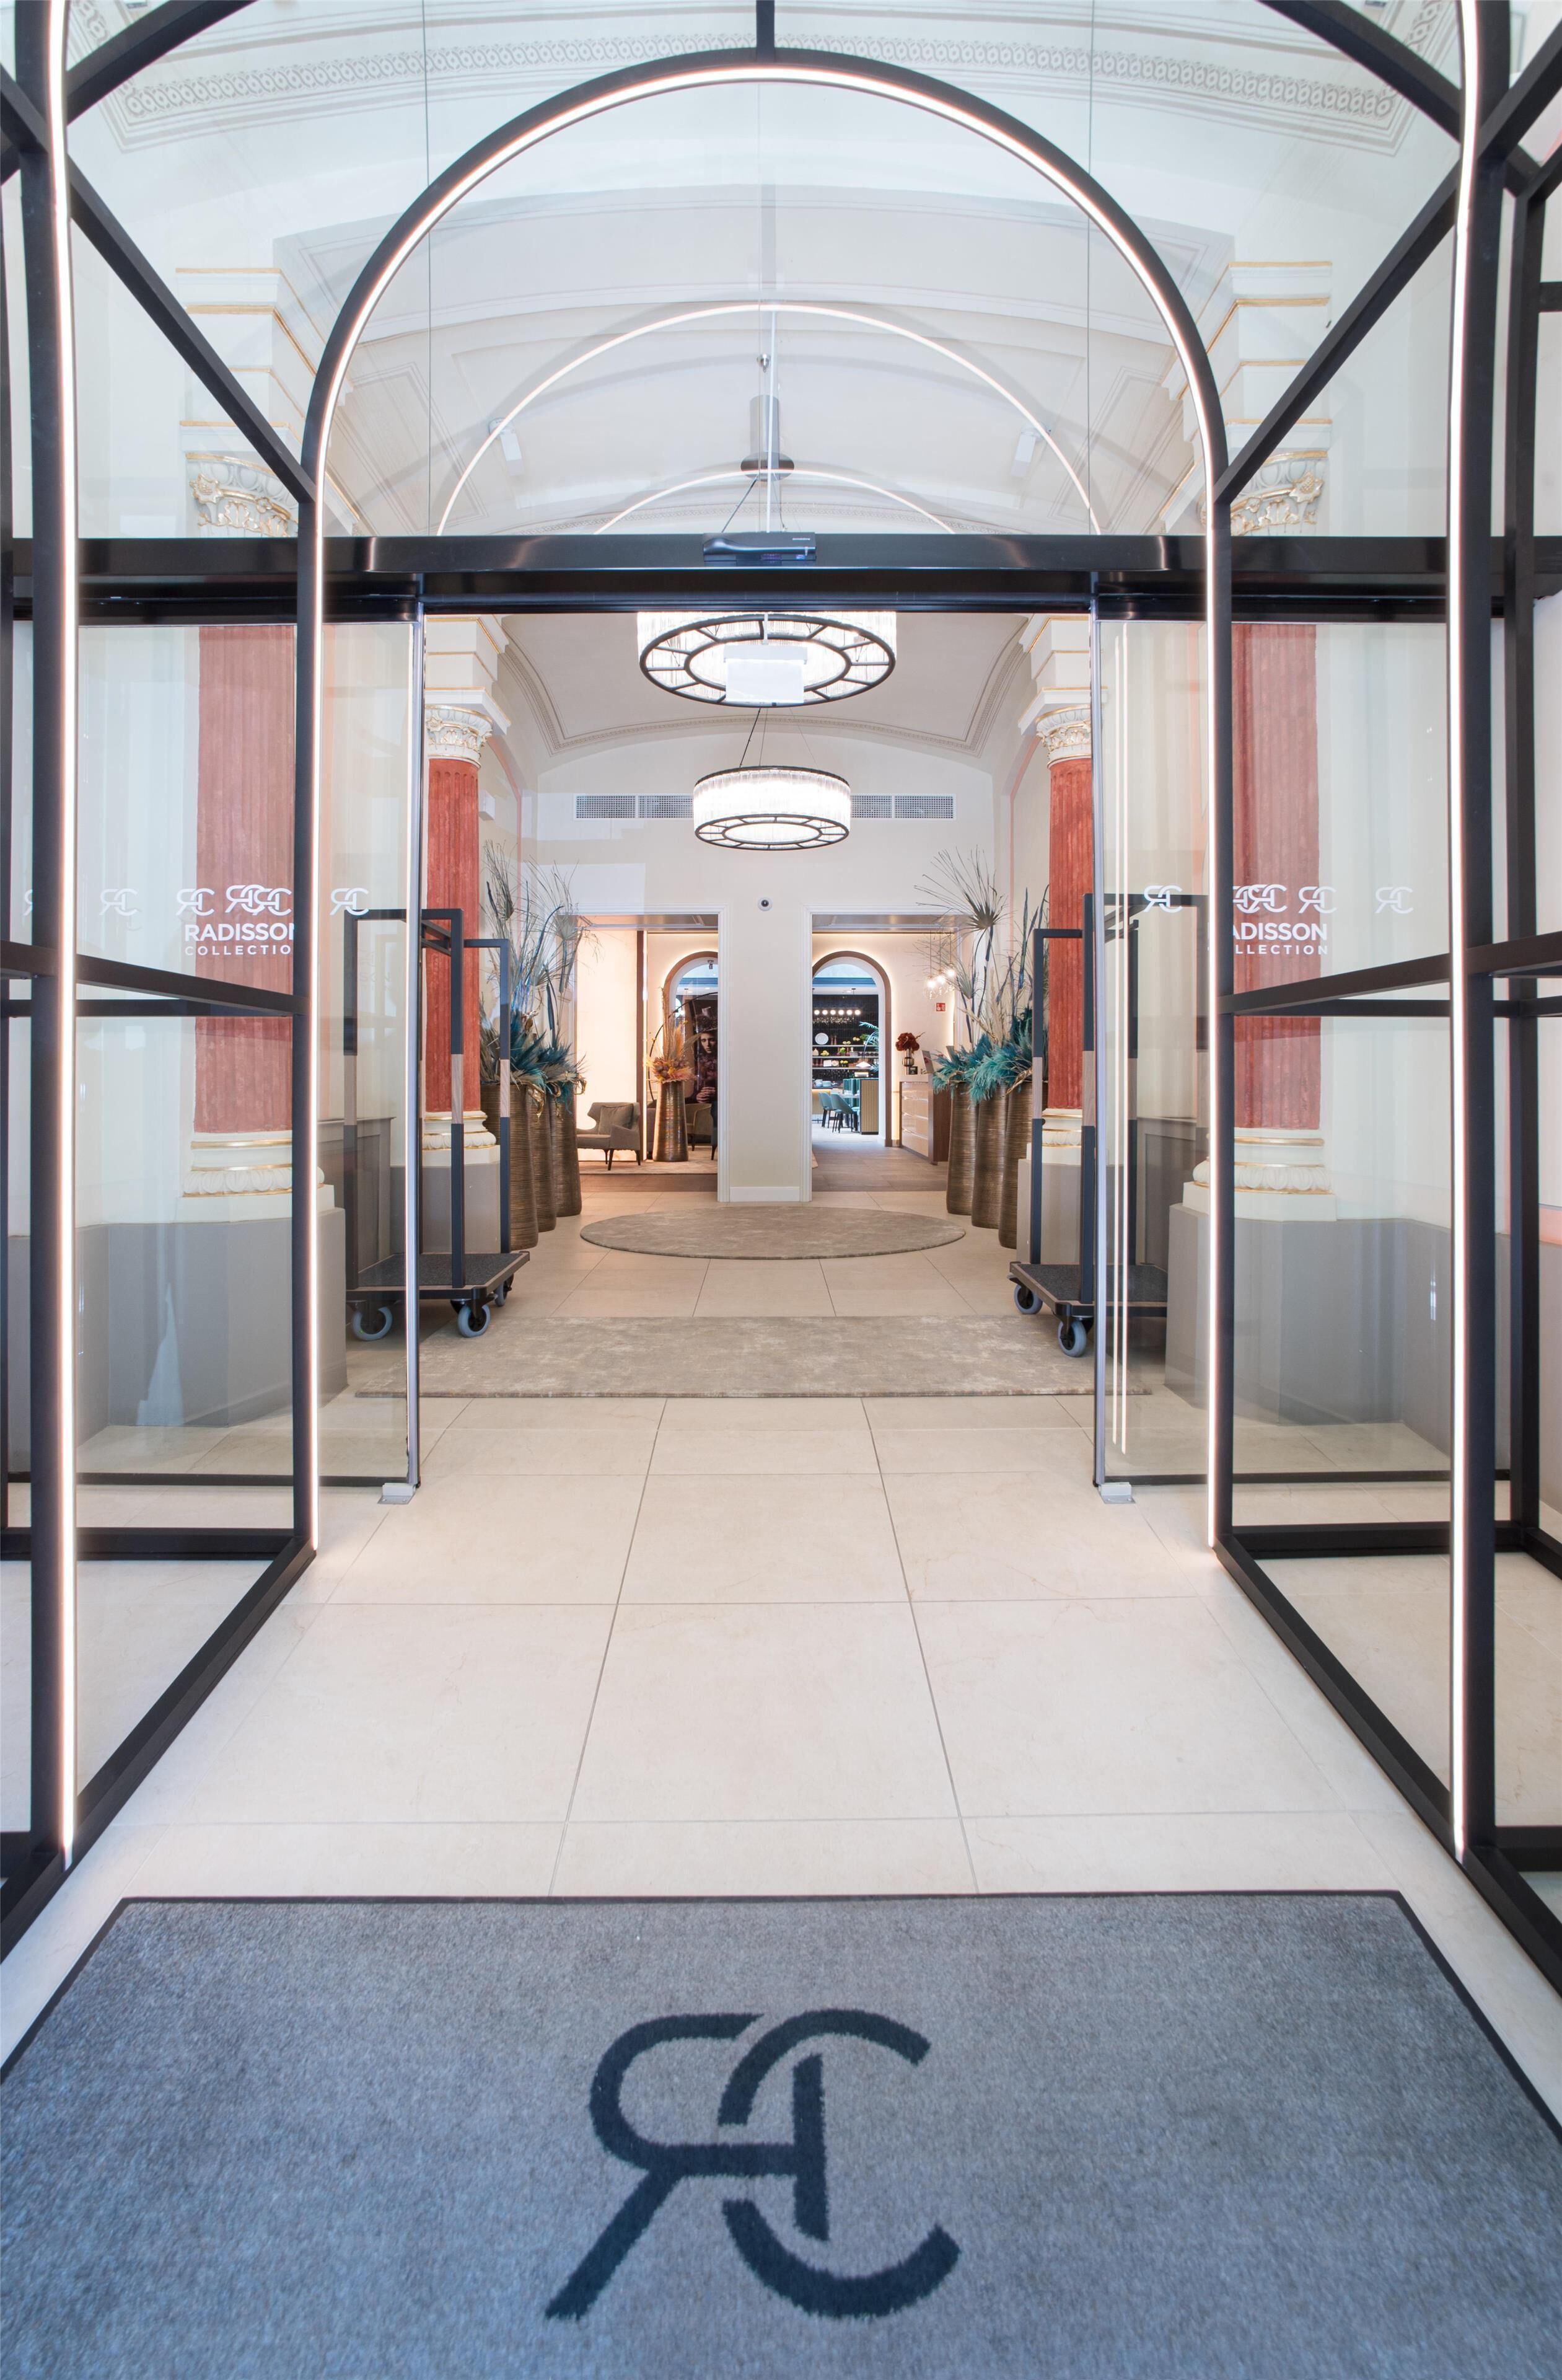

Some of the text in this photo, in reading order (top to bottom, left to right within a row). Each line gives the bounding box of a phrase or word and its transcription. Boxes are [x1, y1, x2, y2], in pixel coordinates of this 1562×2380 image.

[1233, 922, 1327, 941] DISSON
[185, 945, 291, 956] COLLECTIO
[1235, 944, 1328, 955] LLECTION
